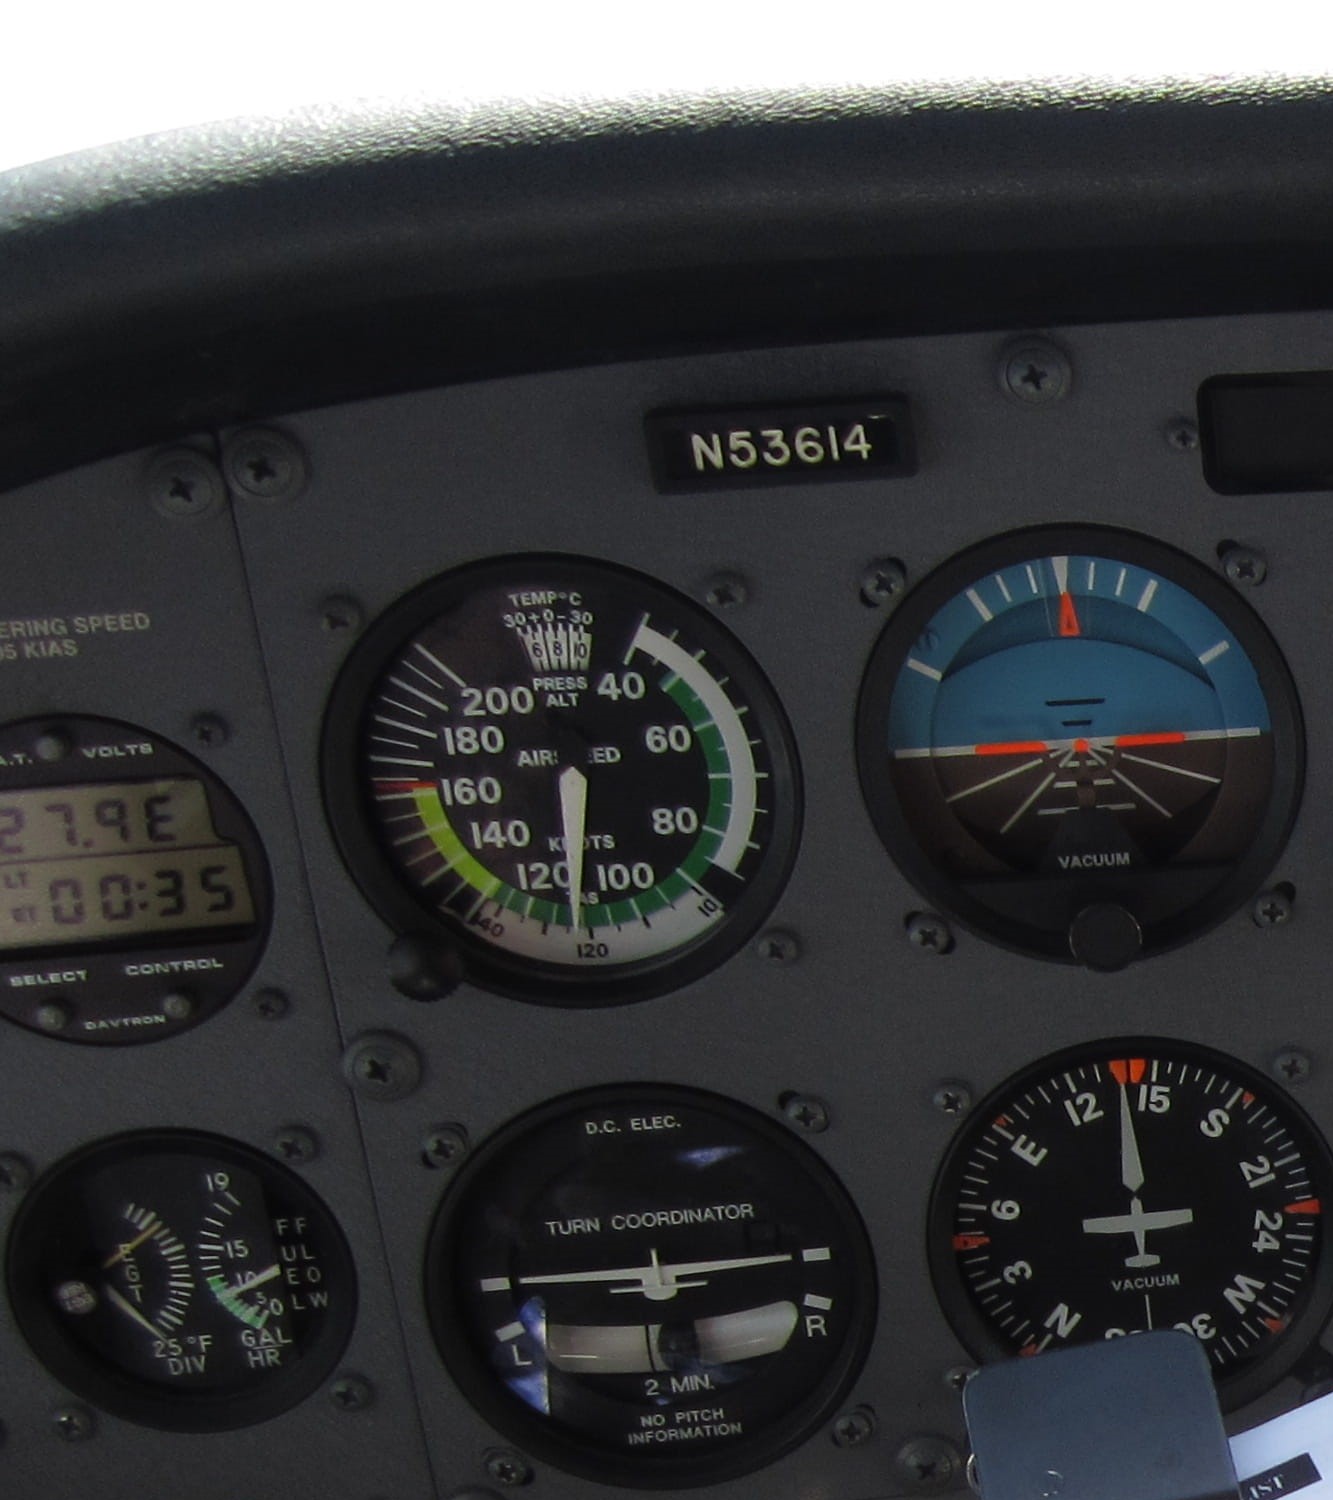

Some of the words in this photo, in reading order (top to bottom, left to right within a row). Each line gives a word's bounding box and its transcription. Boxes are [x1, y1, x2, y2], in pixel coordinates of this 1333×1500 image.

[690, 424, 873, 472] N53614
[74, 612, 149, 632] SPEED
[24, 639, 79, 658] KIAS
[533, 676, 588, 691] PRESS
[597, 672, 645, 700] 40
[462, 687, 535, 717] 200
[546, 692, 579, 708] ALT
[443, 725, 504, 755] 180
[645, 724, 691, 753] 60
[82, 742, 154, 758] VOLTS
[442, 777, 502, 805] 160
[651, 806, 699, 835] 80
[471, 820, 531, 849] 140
[1058, 851, 1130, 869] VACUUM
[597, 861, 655, 890] 100
[50, 865, 235, 924] 00:35
[577, 943, 609, 959] 120
[125, 958, 224, 977] CONTROL
[9, 969, 89, 987] SELECT
[84, 1013, 167, 1031] DAVTRON
[1138, 1084, 1171, 1114] 15
[1064, 1092, 1104, 1127] 12
[585, 1121, 621, 1135] D.C.
[630, 1115, 681, 1131] ELEC.
[206, 1173, 230, 1192] 19
[545, 1217, 601, 1237] TURN
[612, 1203, 754, 1231] COORDINATOR
[225, 1240, 248, 1259] 15
[1111, 1273, 1180, 1292] VACUUM
[241, 1327, 292, 1348] GAL
[168, 1354, 206, 1375] DIV
[248, 1350, 282, 1368] HR
[671, 1374, 715, 1393] MIN.
[640, 1414, 666, 1427] NO
[674, 1408, 725, 1424] PITCH
[628, 1422, 743, 1446] INFORMATION
